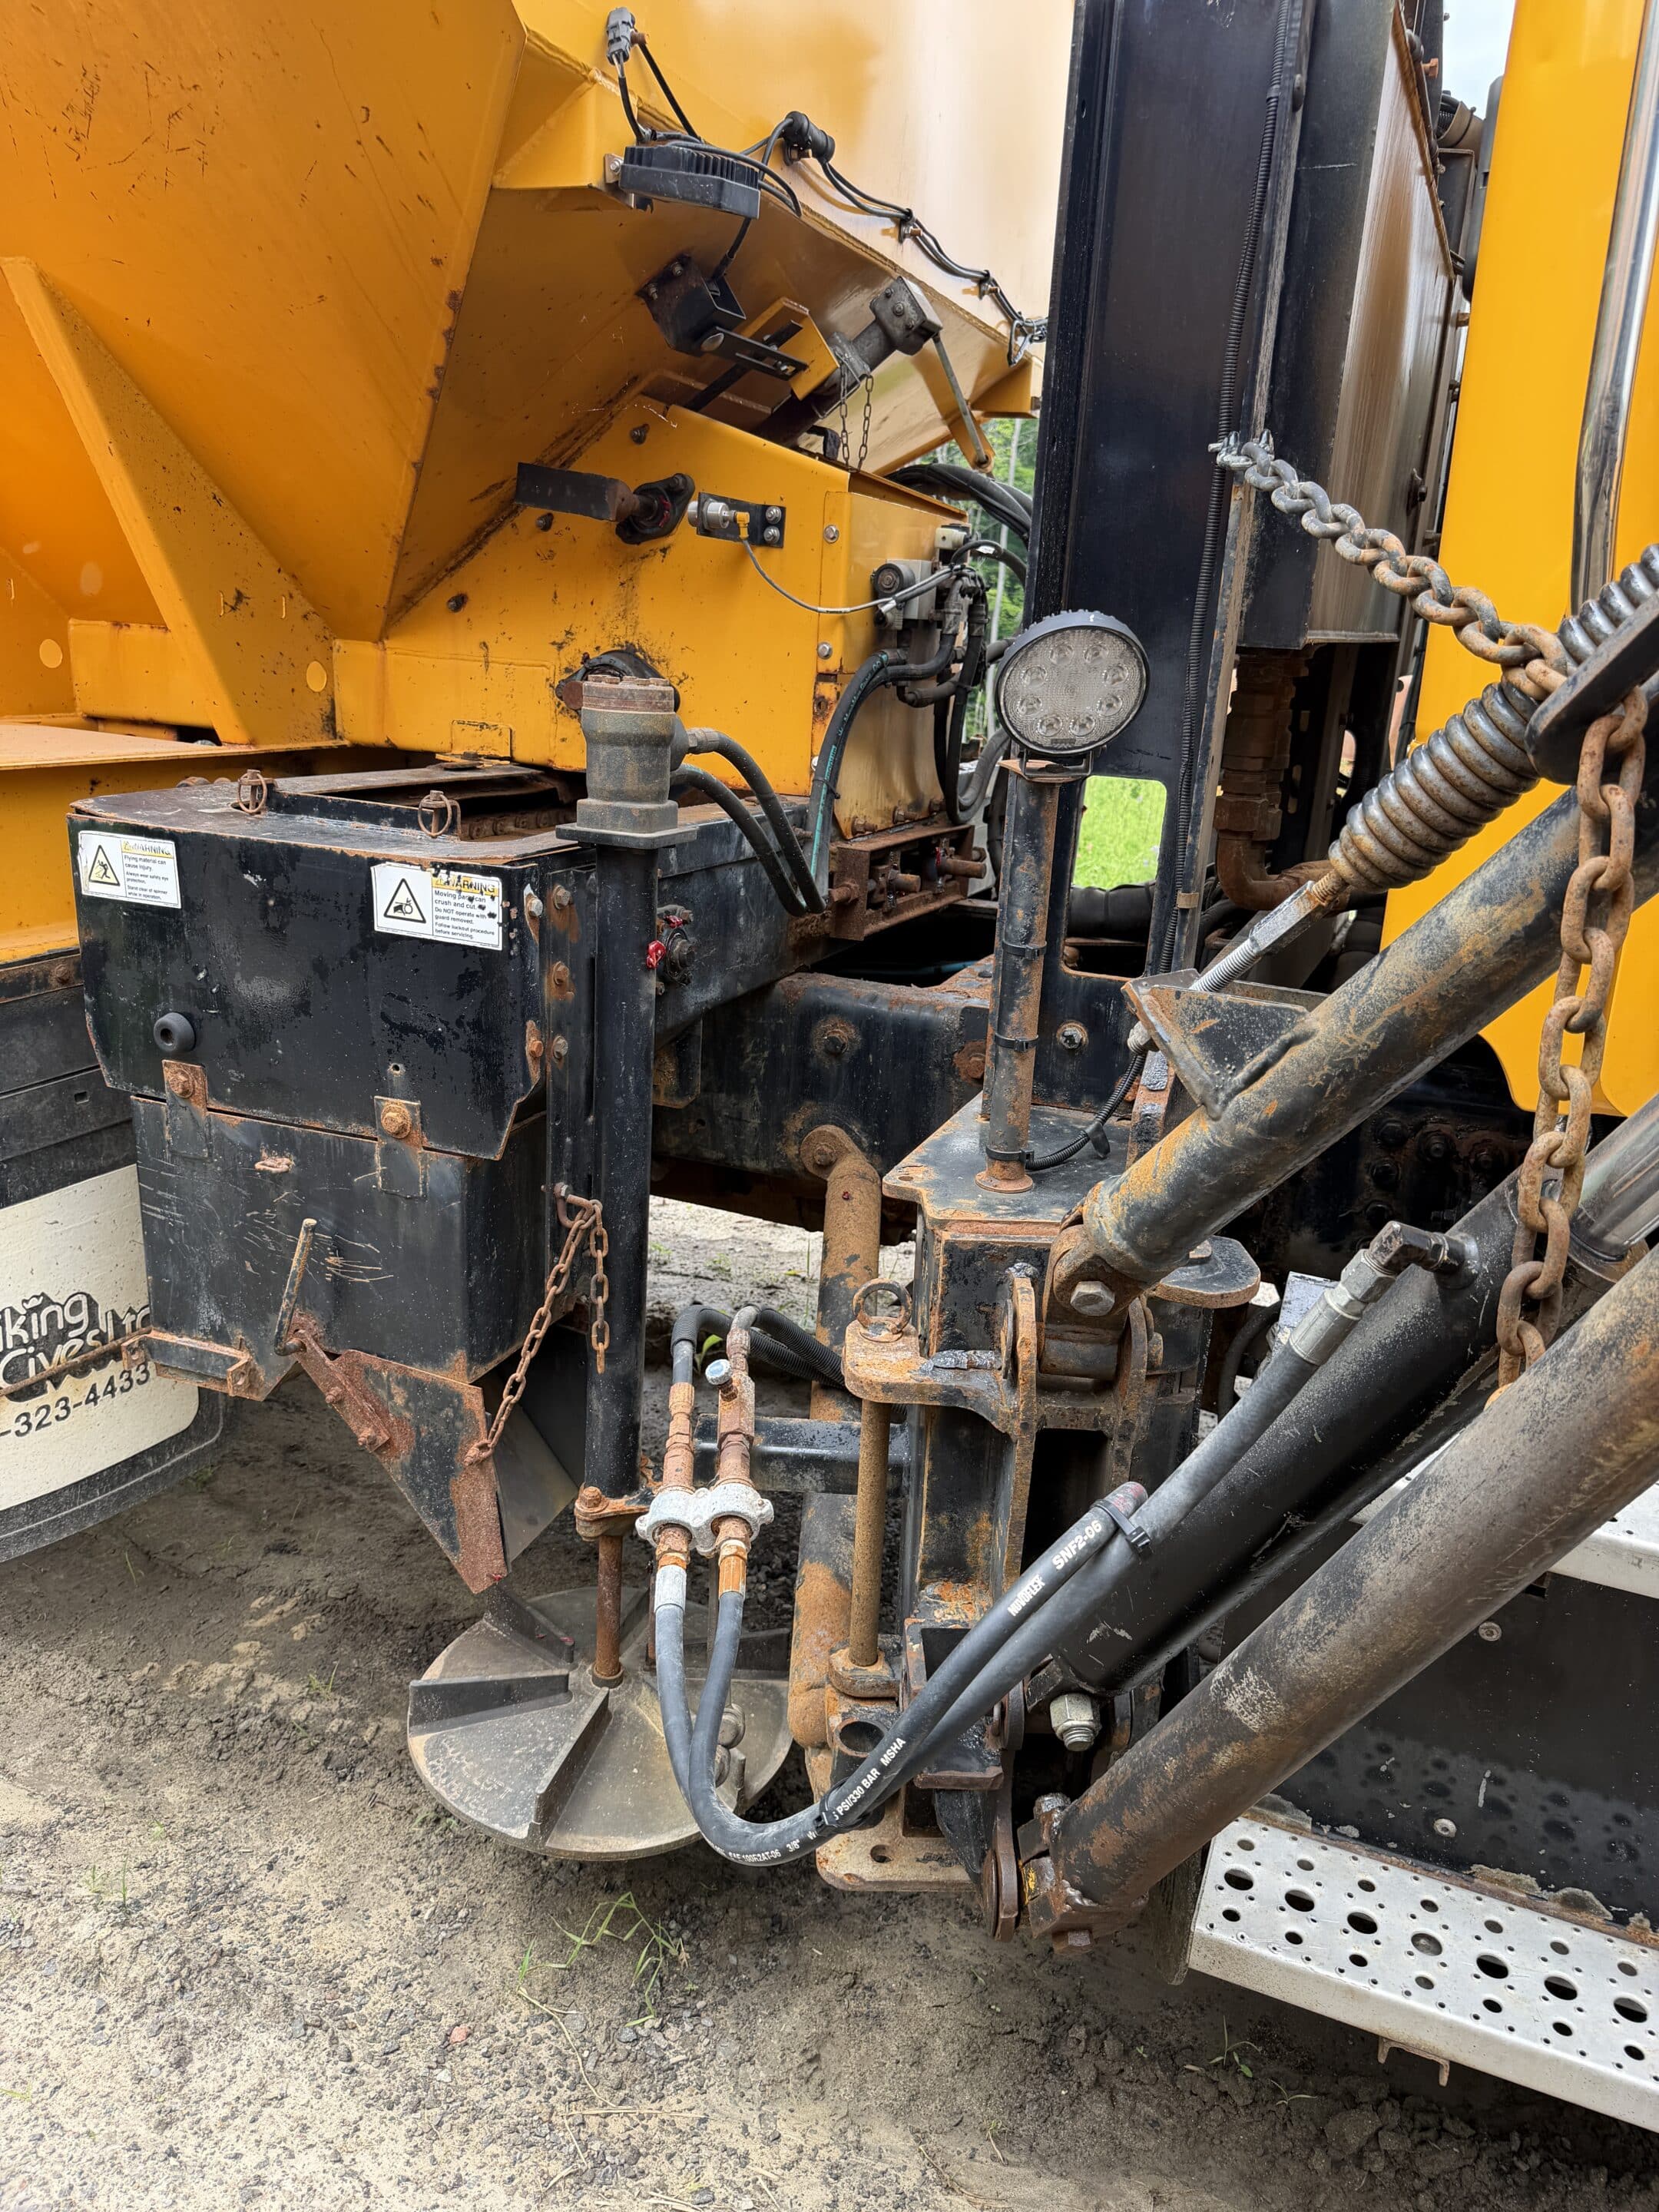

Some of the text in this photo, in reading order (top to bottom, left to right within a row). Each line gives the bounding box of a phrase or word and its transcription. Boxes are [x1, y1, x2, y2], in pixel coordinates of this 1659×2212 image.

[435, 890, 456, 899] Moving
[470, 928, 495, 936] procedure
[836, 1737, 906, 1816] PSI/330 BAR MSHA
